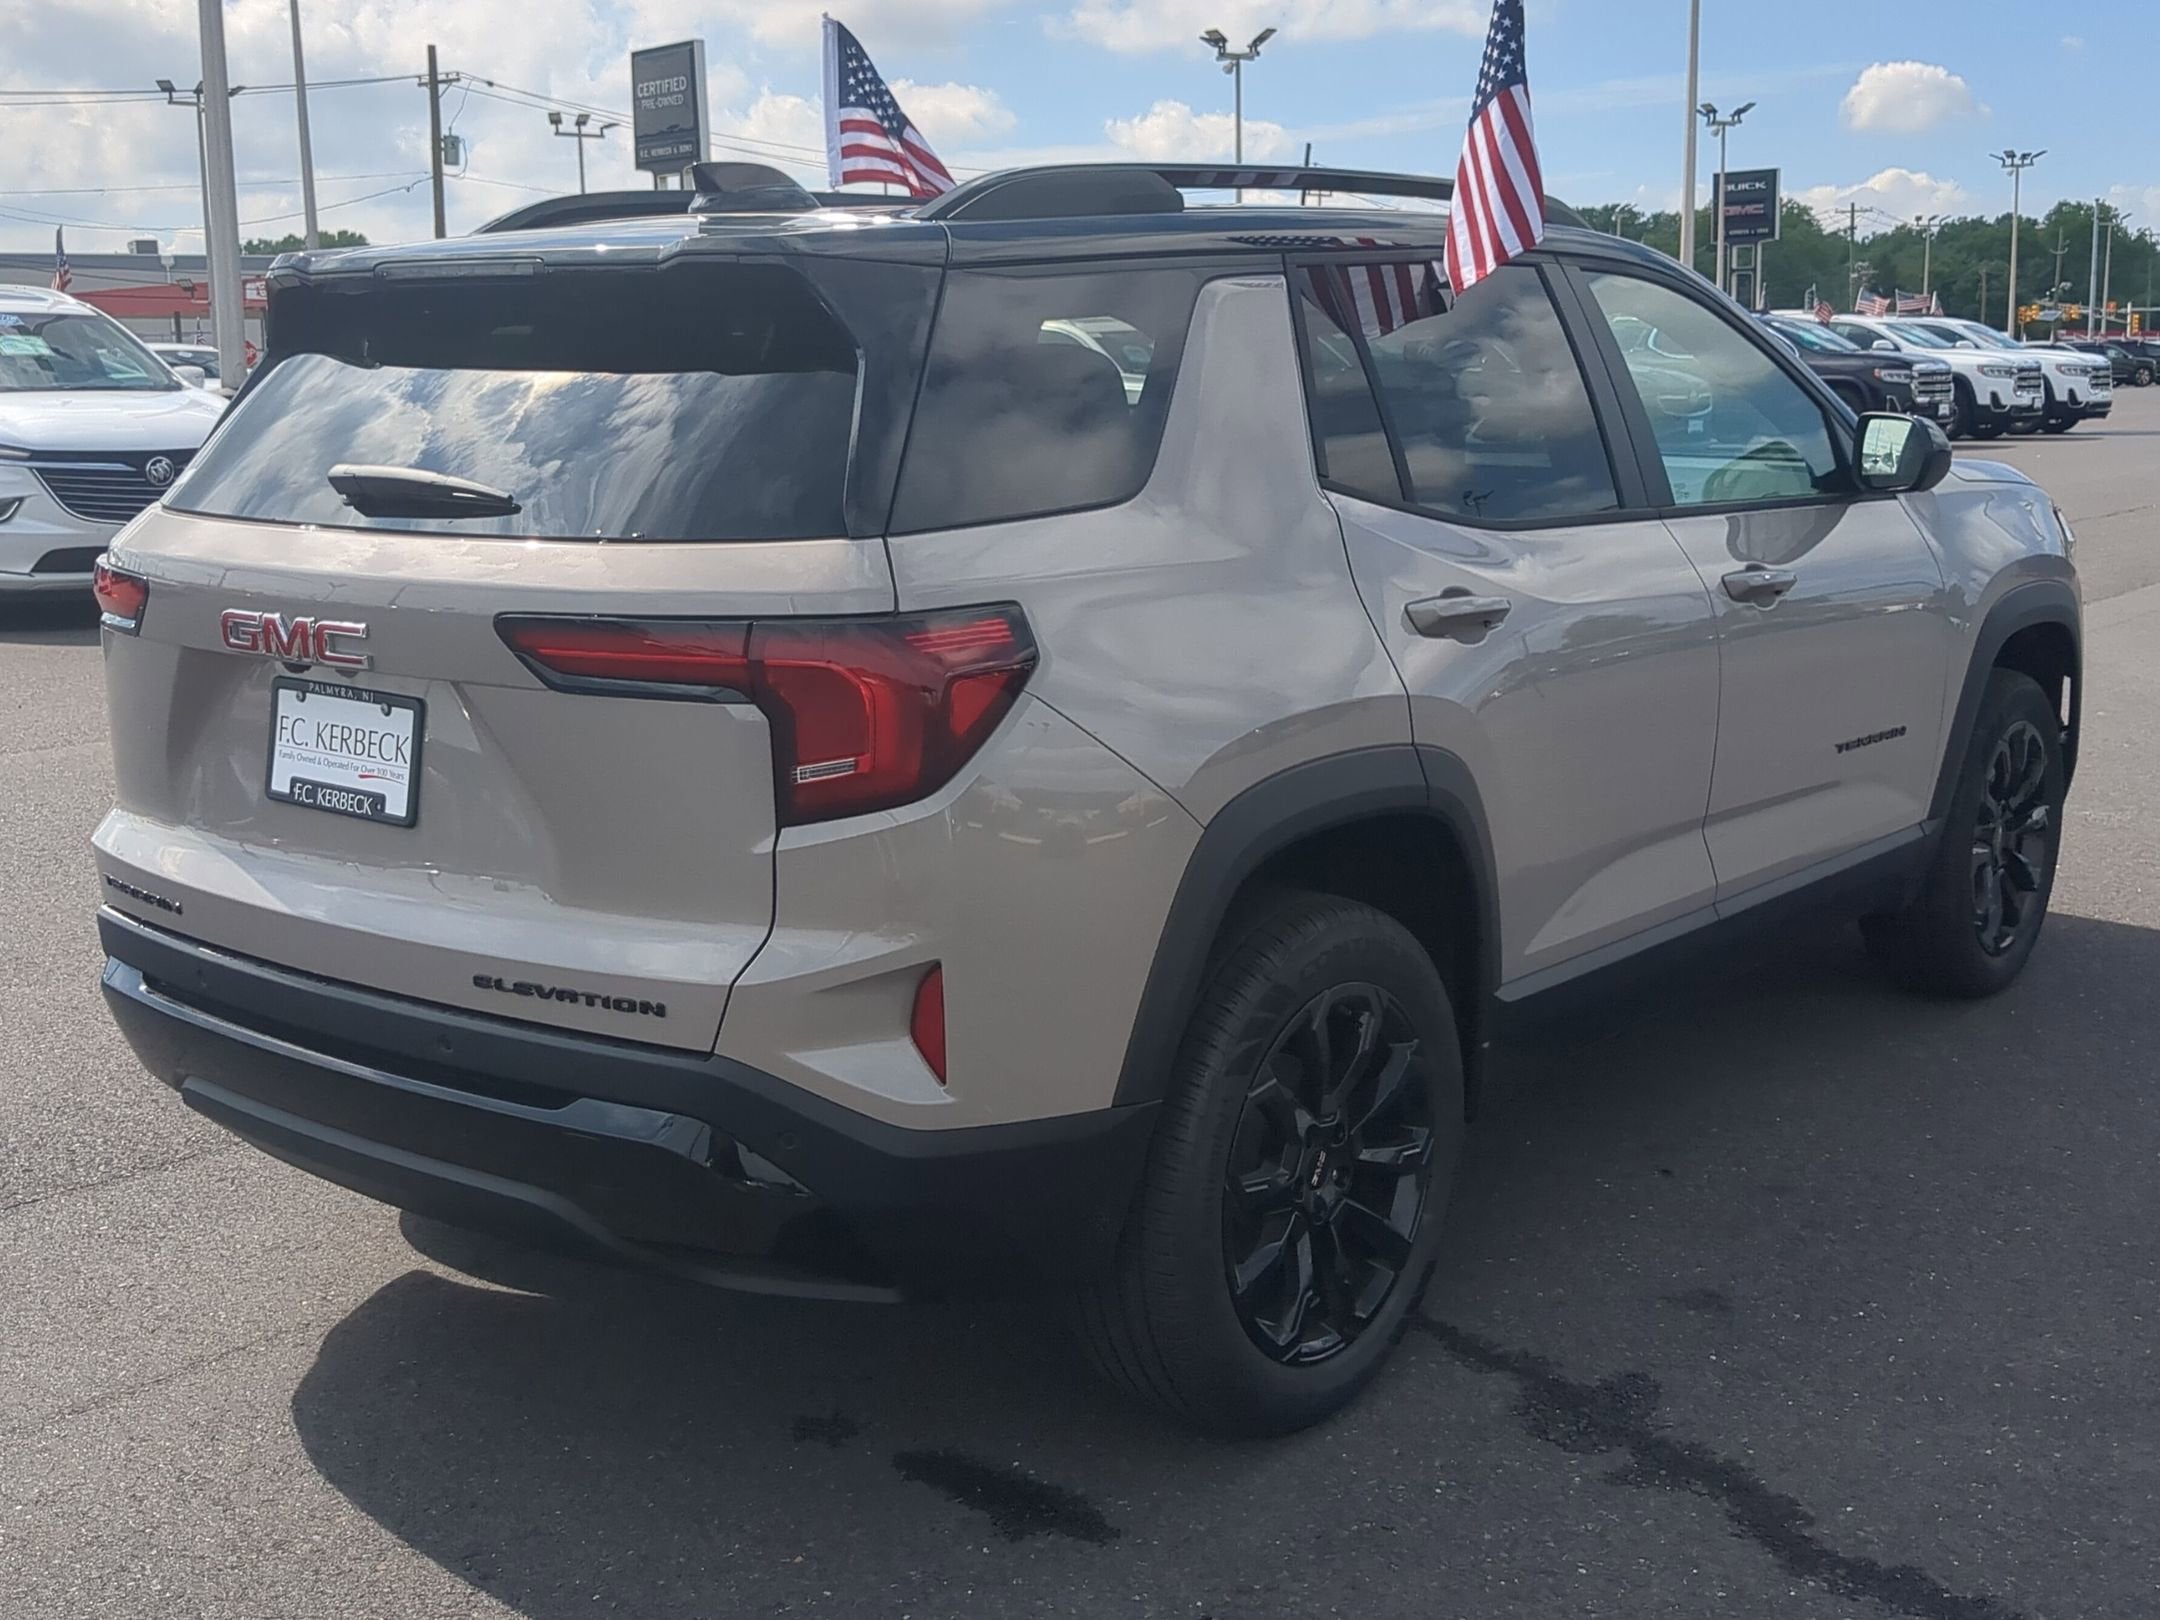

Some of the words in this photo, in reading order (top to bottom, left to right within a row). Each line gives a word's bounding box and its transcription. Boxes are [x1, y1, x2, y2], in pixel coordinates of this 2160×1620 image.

[637, 76, 687, 98] CERTIFIED
[641, 95, 684, 110] PRE-OWNED
[221, 608, 372, 671] GMC
[362, 691, 374, 703] NJ
[279, 715, 309, 747] F.C.
[315, 721, 409, 764] KERBECK
[317, 787, 373, 815] KERBECK
[473, 974, 666, 1018] ELEVATION
